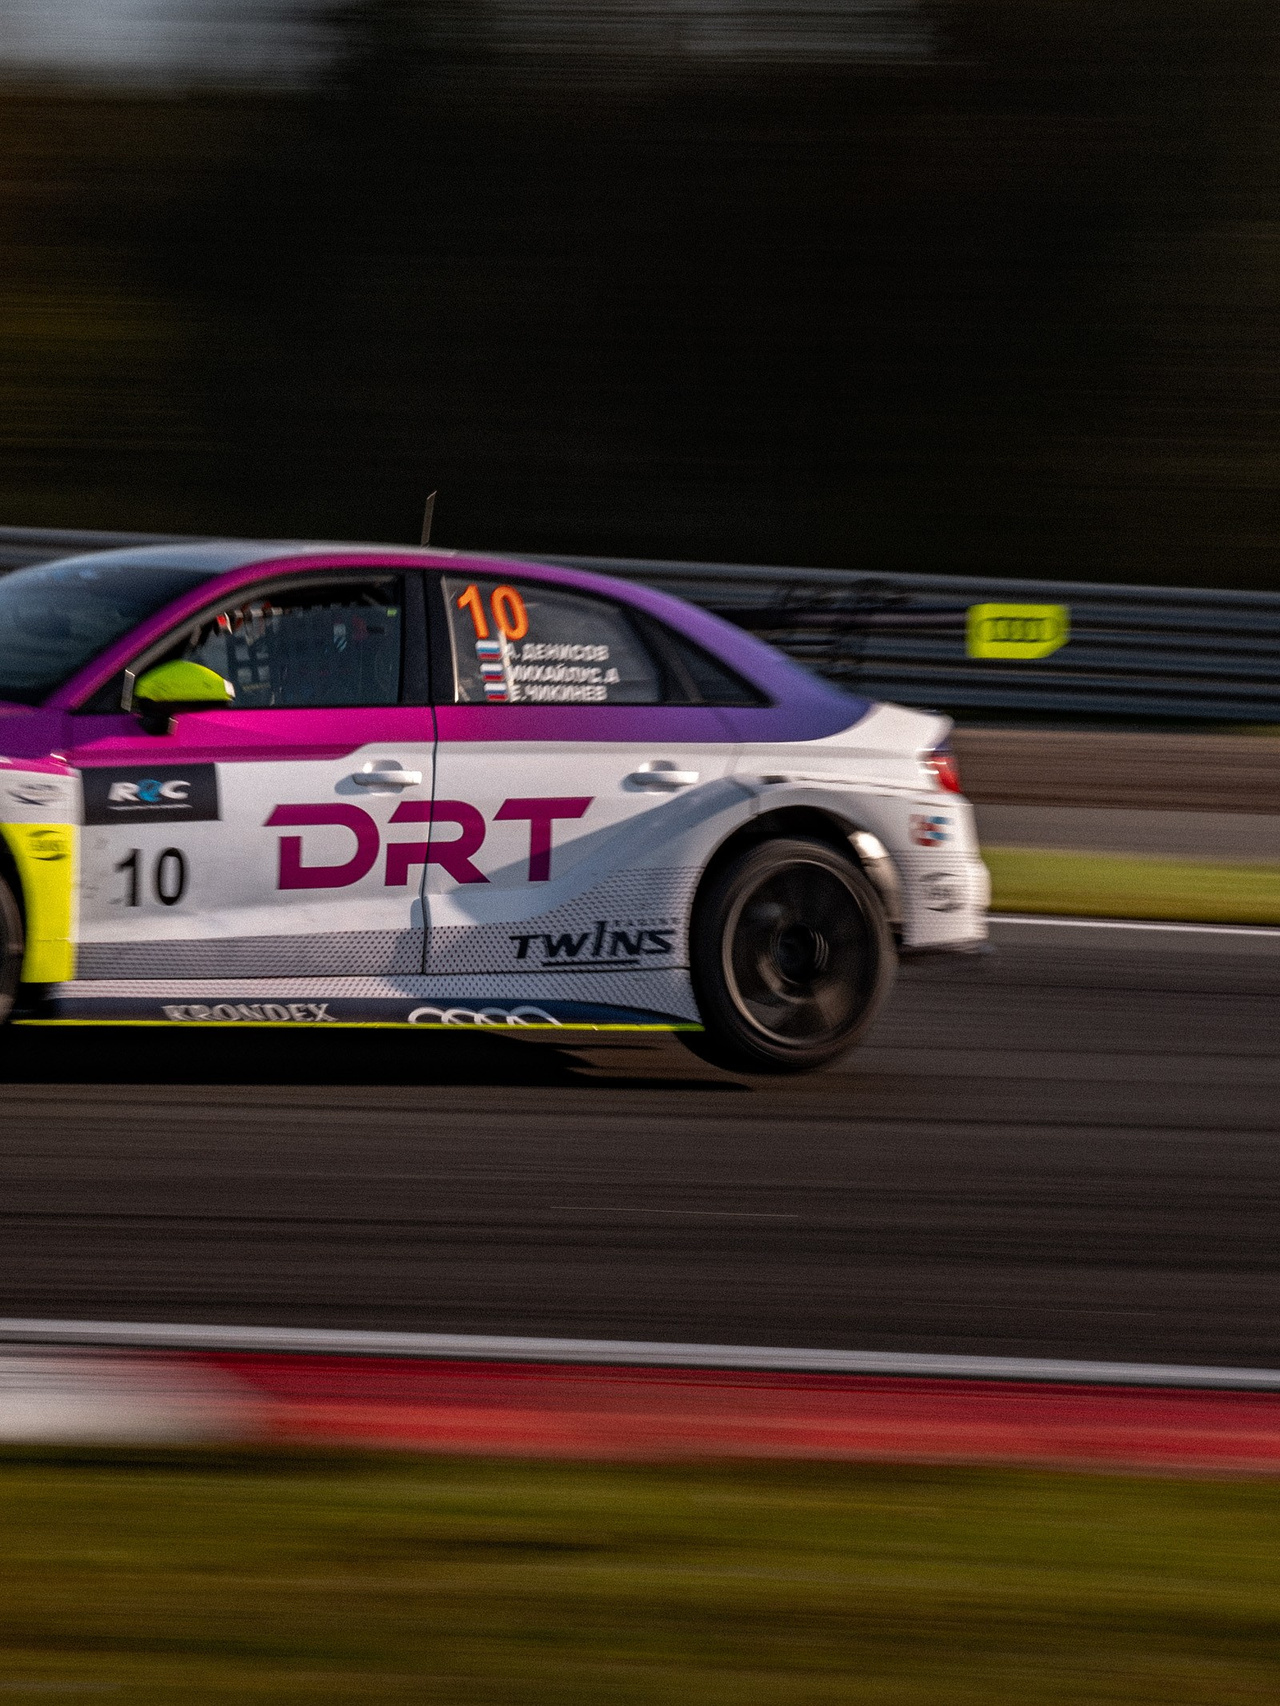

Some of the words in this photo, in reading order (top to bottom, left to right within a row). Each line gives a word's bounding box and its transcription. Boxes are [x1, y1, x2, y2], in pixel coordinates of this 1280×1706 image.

[457, 583, 529, 640] 10
[264, 797, 596, 891] DRT
[115, 847, 190, 906] 10
[509, 920, 675, 959] TWINS
